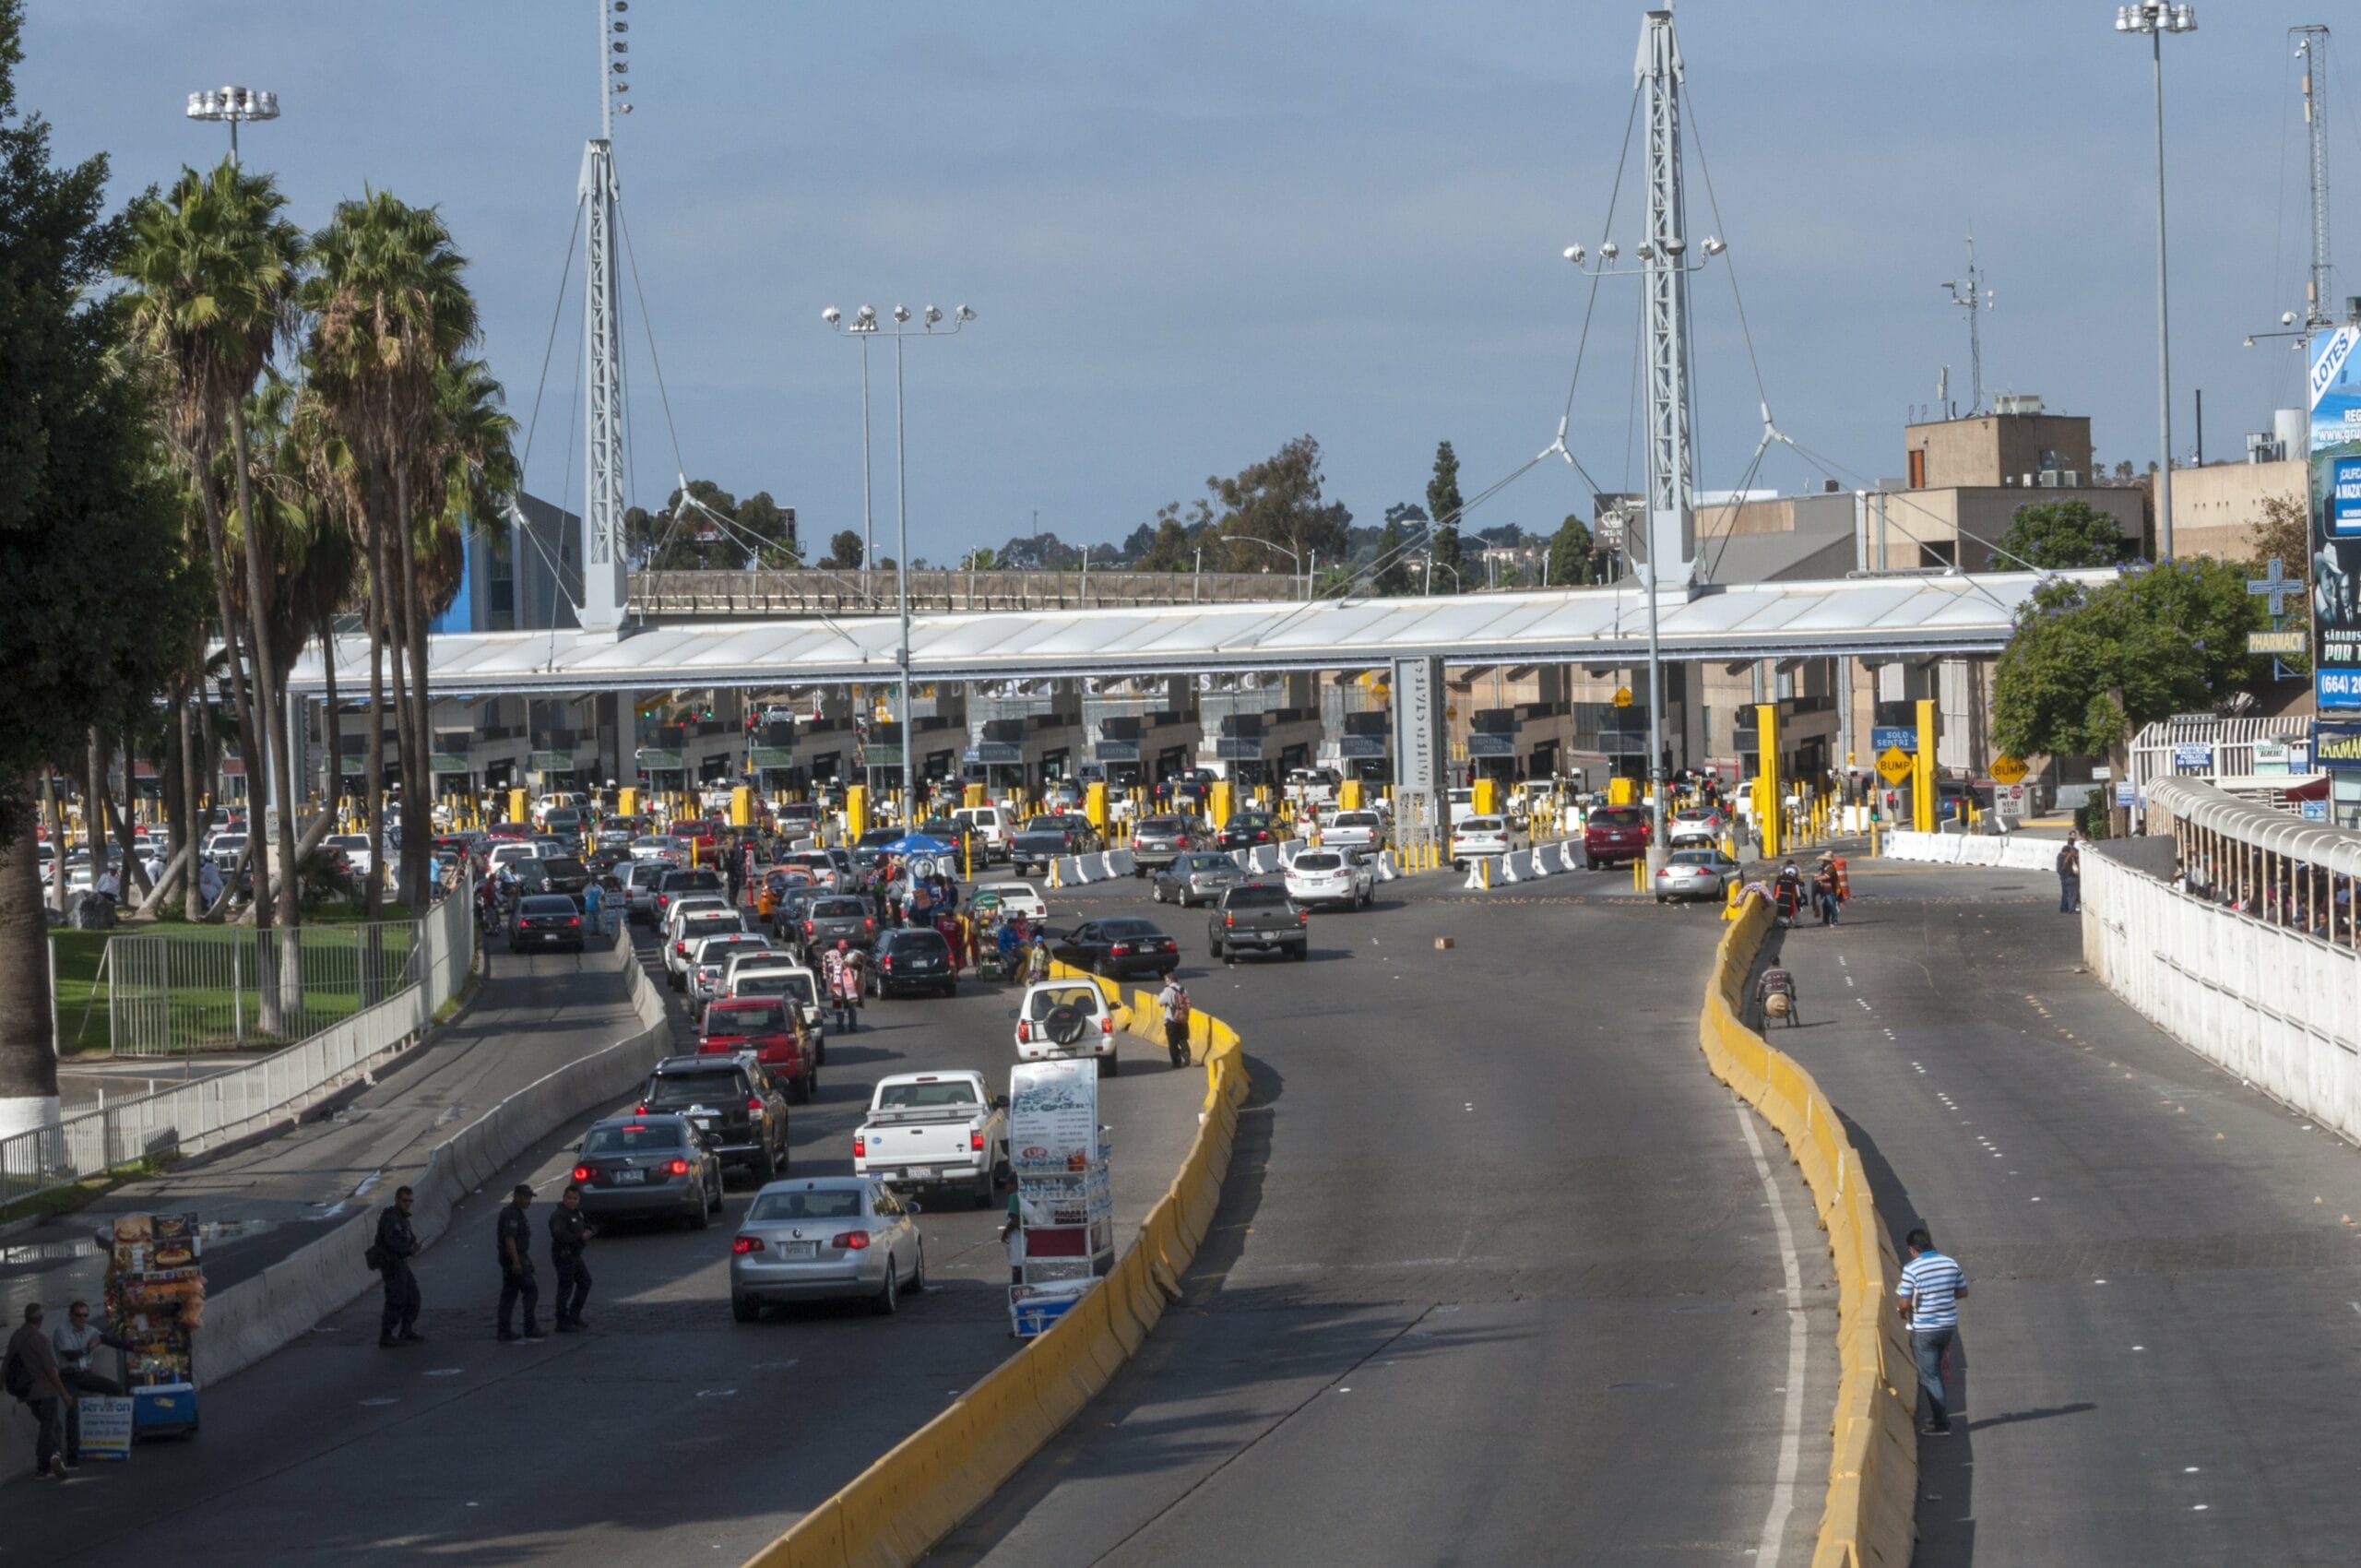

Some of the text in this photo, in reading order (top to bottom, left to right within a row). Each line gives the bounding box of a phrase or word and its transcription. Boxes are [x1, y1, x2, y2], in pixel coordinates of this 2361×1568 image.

[2312, 333, 2349, 392] LOTES
[2318, 429, 2361, 444] www.gru
[2248, 633, 2303, 651] PHARMACY
[2324, 644, 2353, 661] POR
[2321, 675, 2349, 694] (664)
[2318, 737, 2361, 759] FARMA
[1880, 761, 1911, 771] BUMP
[1995, 765, 2024, 776] BUMP
